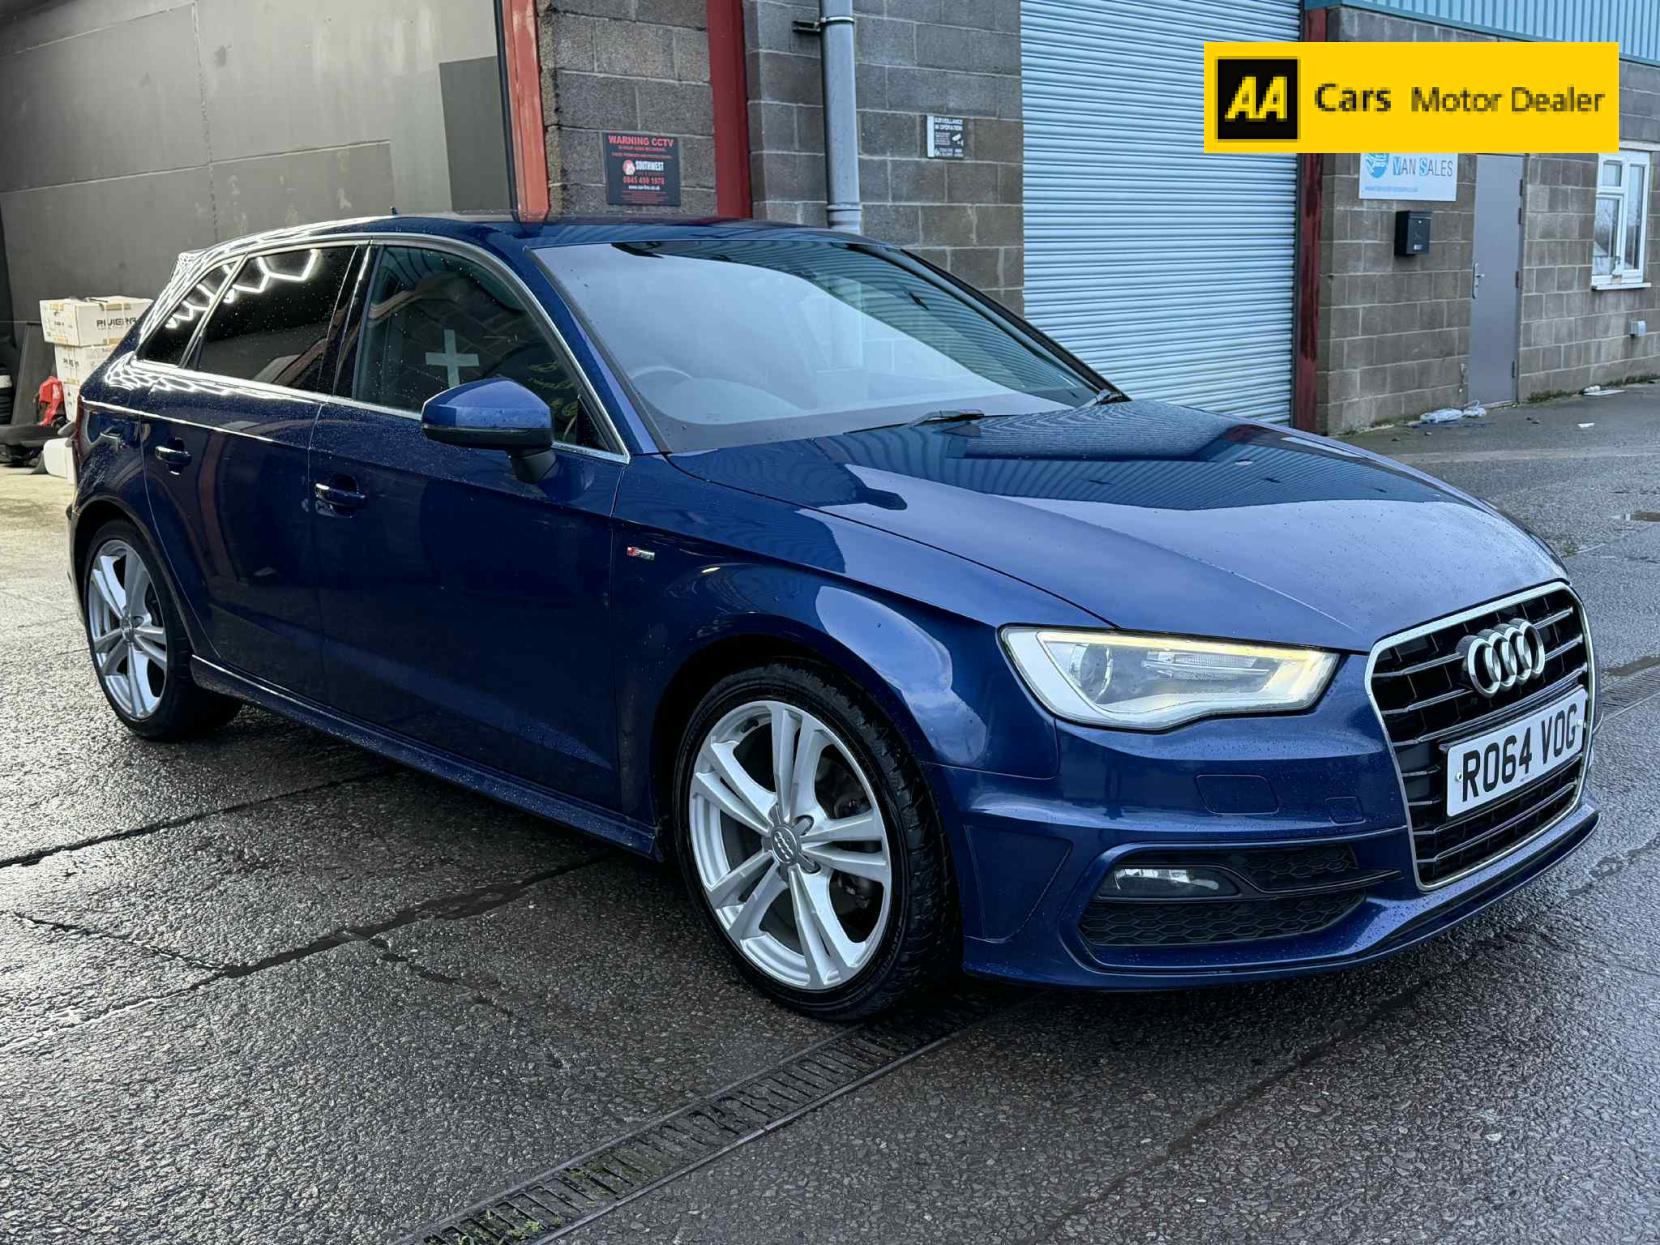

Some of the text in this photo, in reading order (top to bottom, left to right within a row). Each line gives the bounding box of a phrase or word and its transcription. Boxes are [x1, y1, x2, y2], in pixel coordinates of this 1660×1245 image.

[608, 135, 674, 147] WARNING CCTV
[1393, 157, 1453, 177] VAN SALES
[1462, 703, 1578, 803] RO64 VOG
